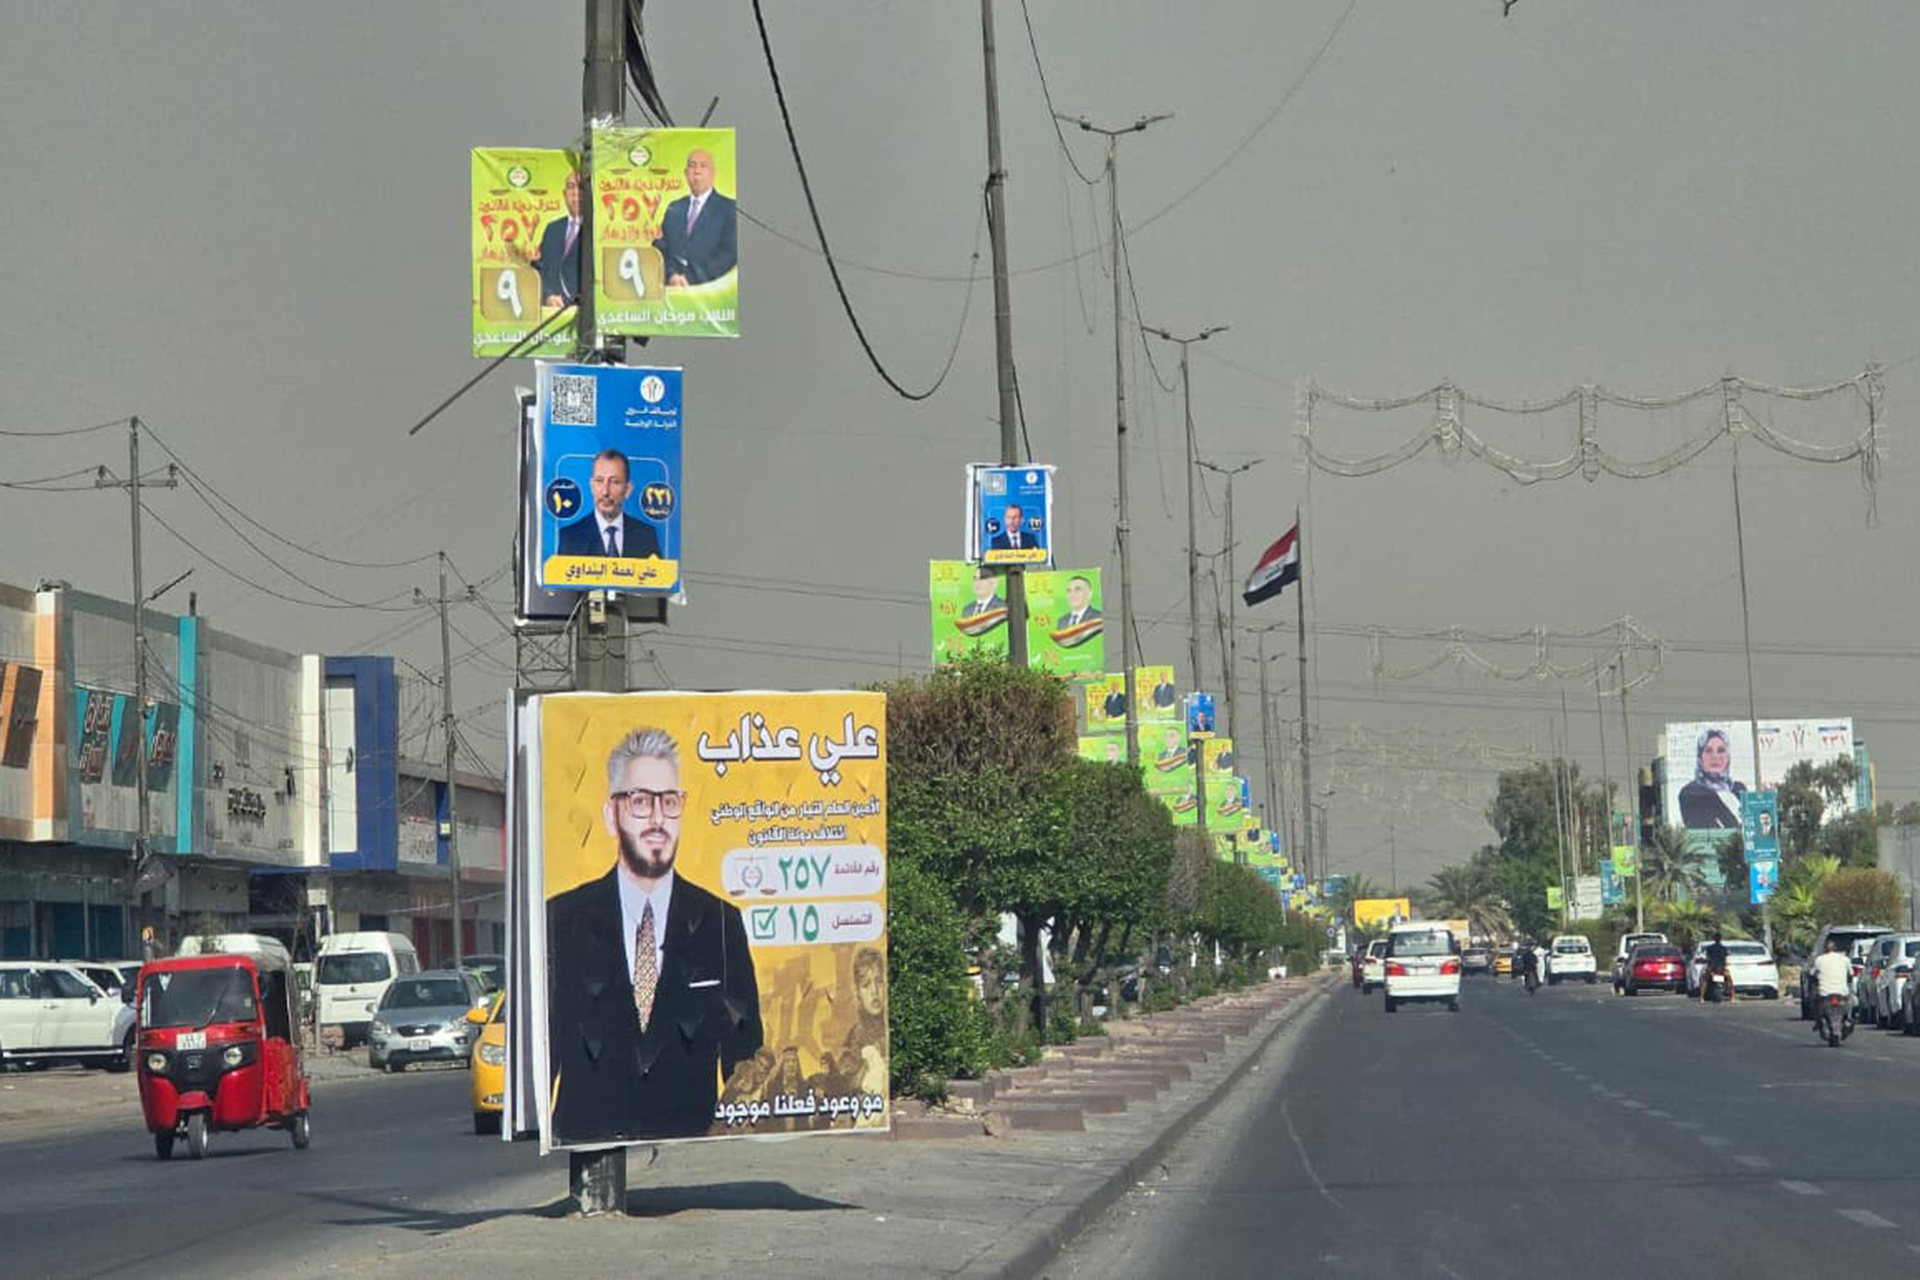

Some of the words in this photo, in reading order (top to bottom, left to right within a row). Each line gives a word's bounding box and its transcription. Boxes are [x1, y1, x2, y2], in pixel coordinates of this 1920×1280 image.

[601, 193, 662, 221] ٢٥٧
[481, 214, 541, 242] ٢٥٧
[618, 248, 645, 298] ٩
[497, 269, 522, 319] ٩
[598, 309, 651, 325] الساعدي
[553, 491, 573, 514] ١٠
[638, 564, 658, 584] علي
[697, 712, 802, 778] عذاب
[809, 712, 880, 787] علي
[709, 801, 748, 825] الوطني
[780, 802, 796, 818] من
[747, 825, 787, 847] القانون
[778, 854, 832, 891] ٢٥٧
[864, 861, 880, 876] رقم
[788, 904, 820, 943] ١٥
[714, 1100, 771, 1126] موجود
[773, 1088, 817, 1117] فعلنا
[818, 1095, 859, 1119] وعود
[862, 1095, 884, 1120] مو
